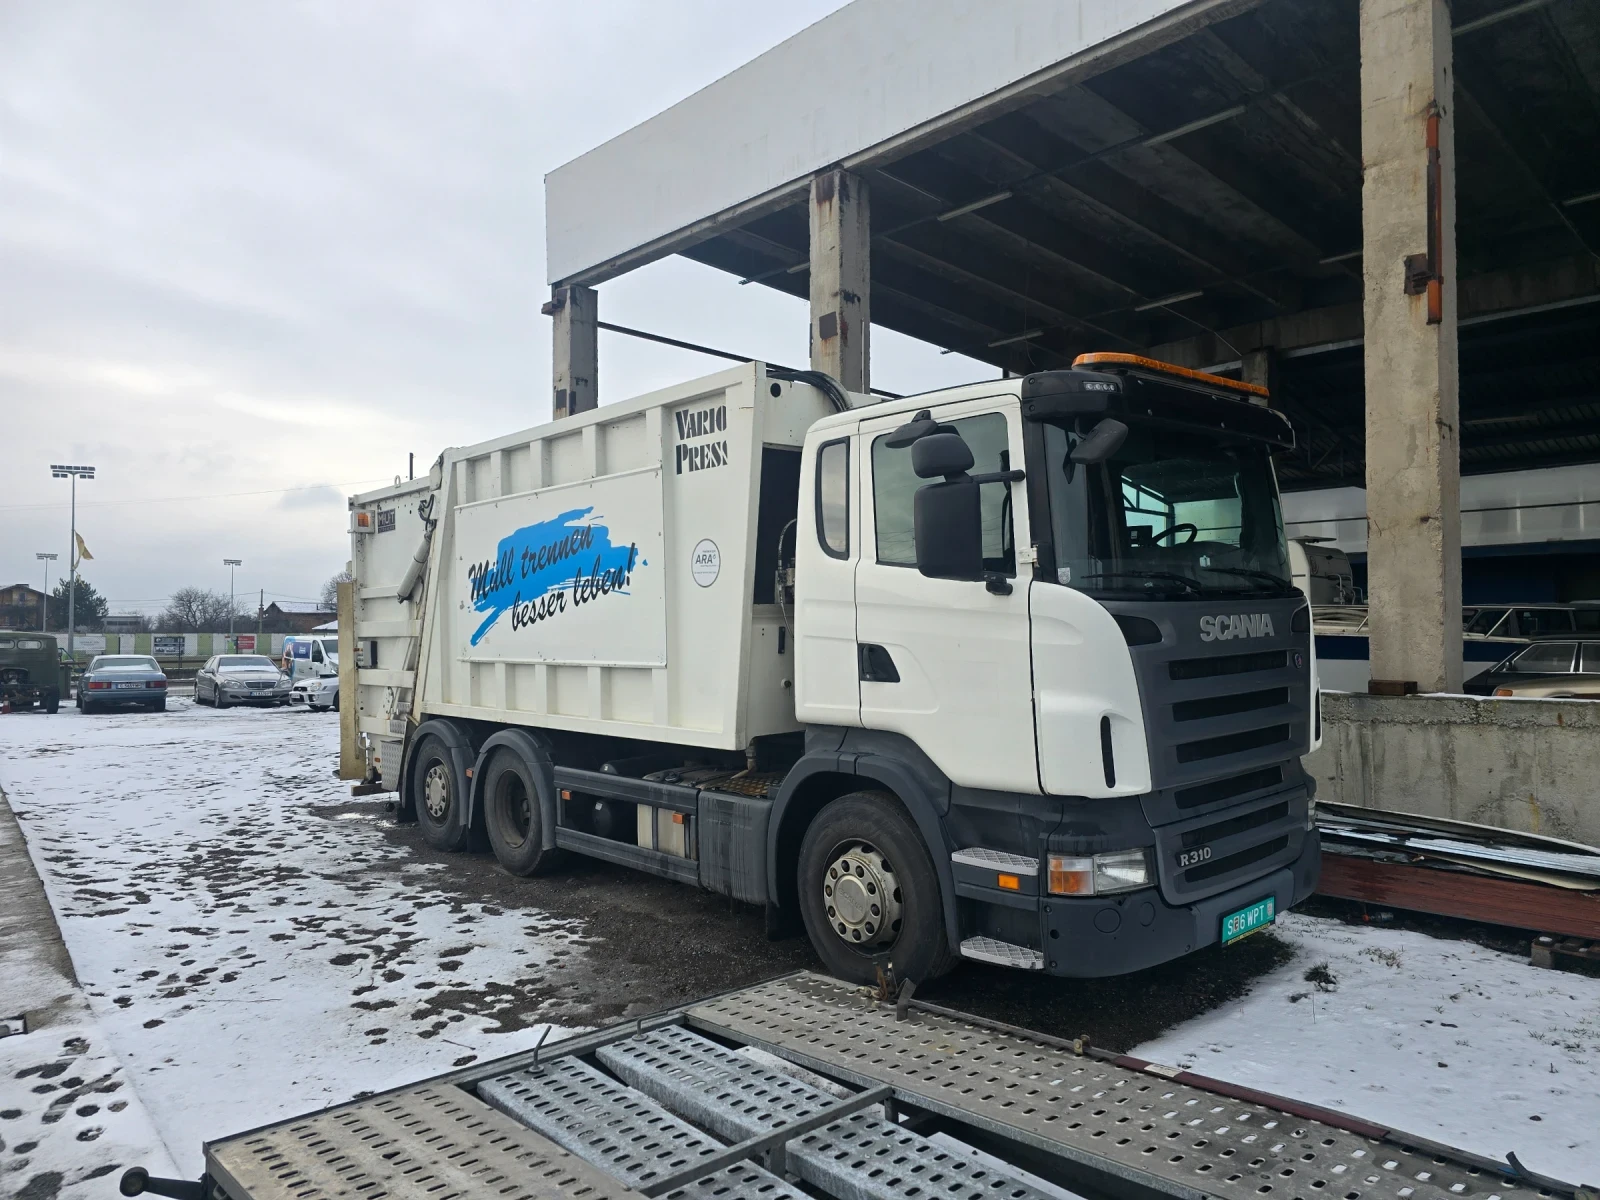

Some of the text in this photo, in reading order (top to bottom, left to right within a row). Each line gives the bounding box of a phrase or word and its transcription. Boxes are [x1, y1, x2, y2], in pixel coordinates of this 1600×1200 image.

[675, 405, 727, 441] VARIO
[675, 440, 728, 475] PRESS
[468, 523, 594, 603] Müll trennen
[511, 542, 636, 632] besser leben!
[1200, 613, 1275, 642] SCANIA
